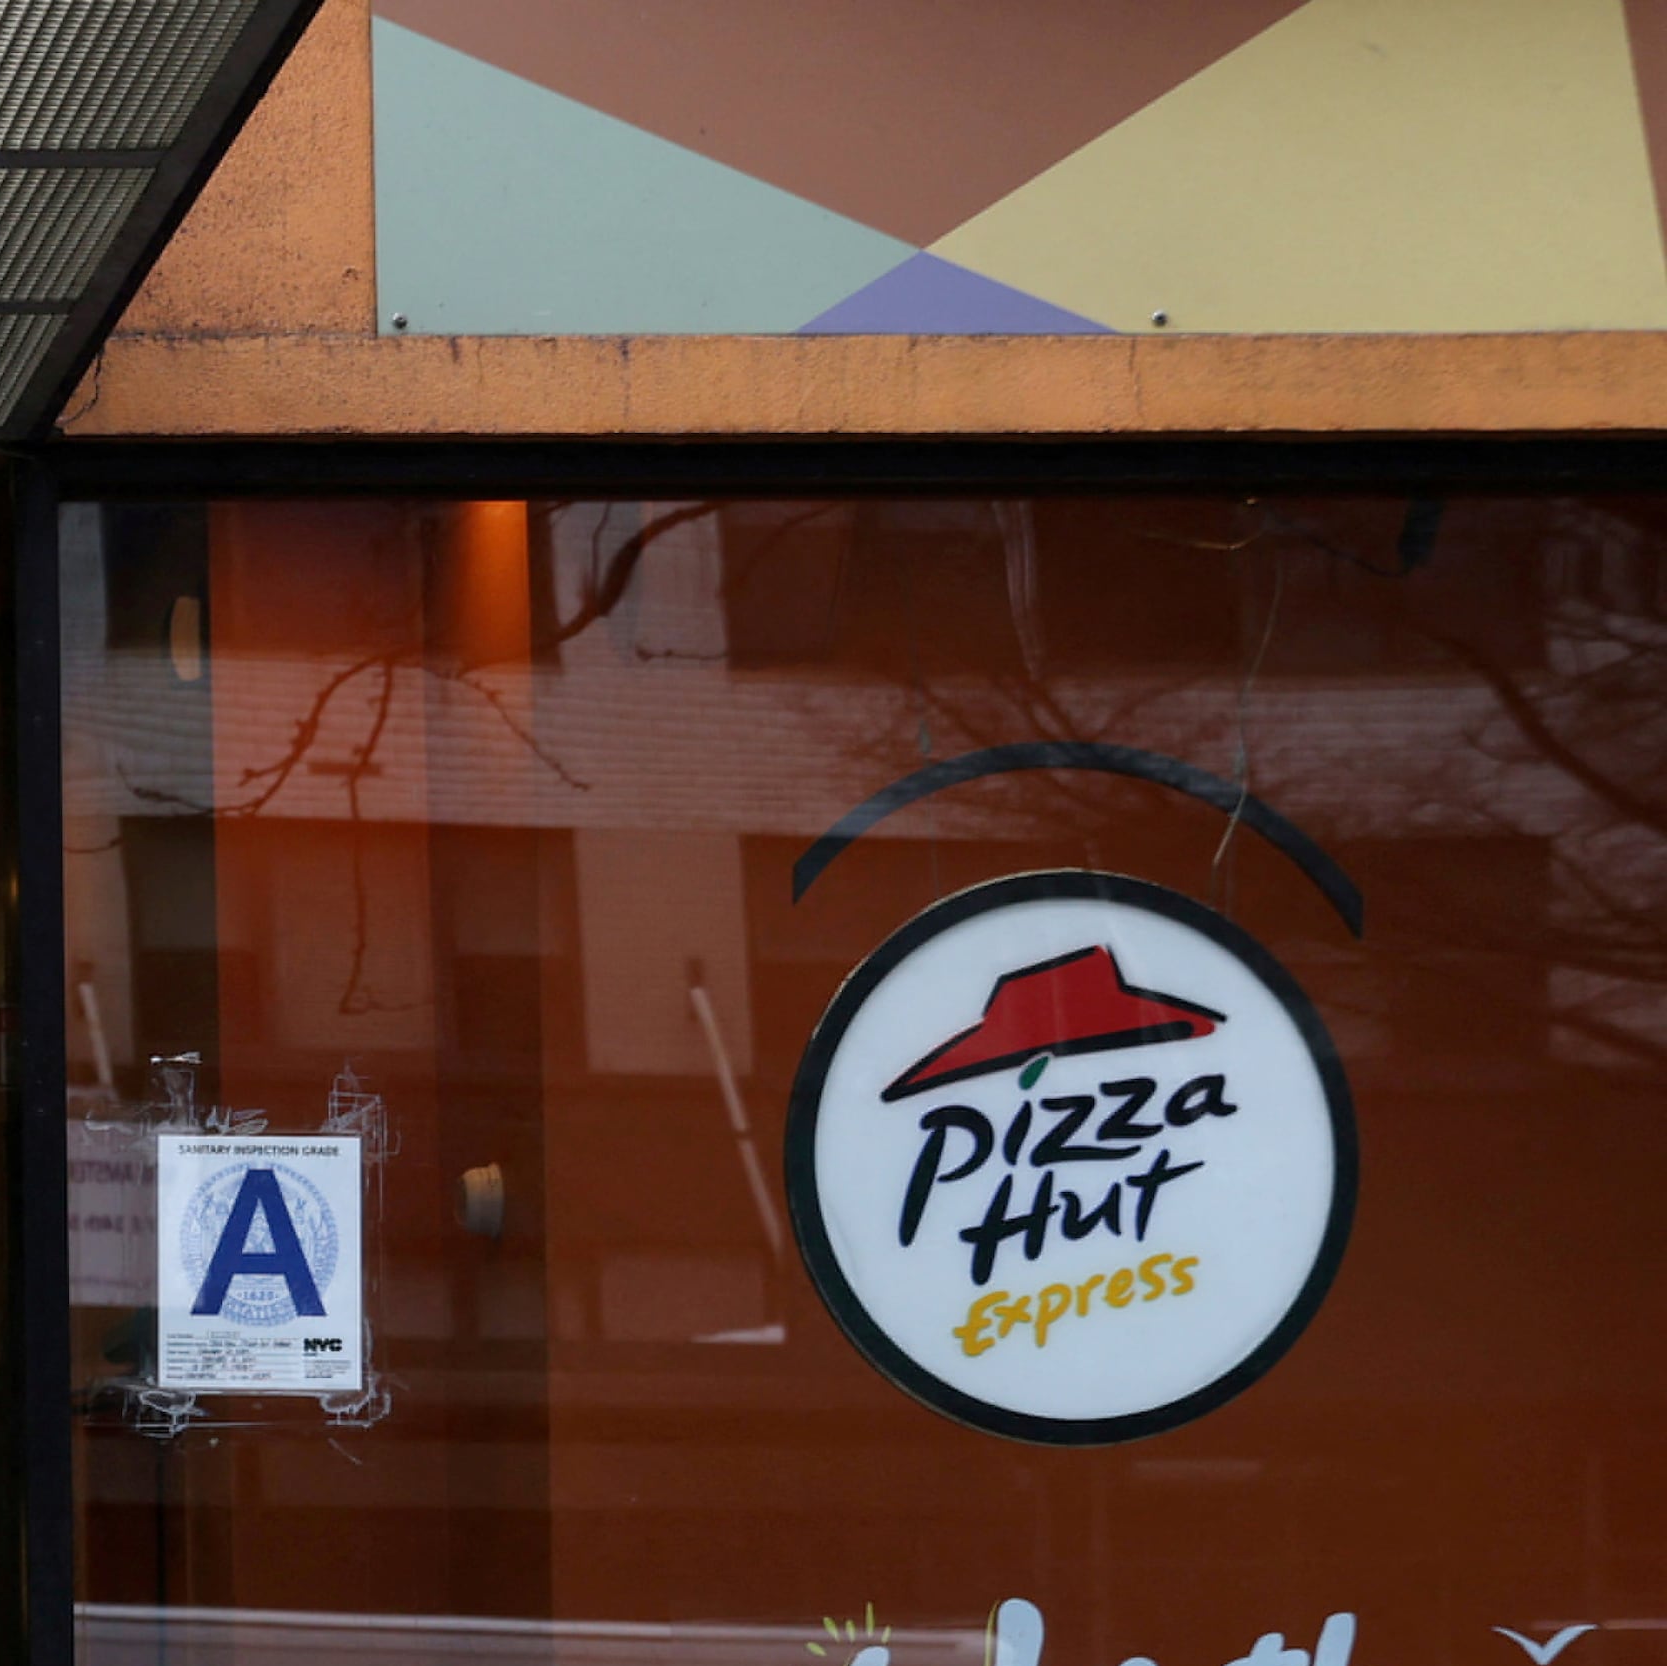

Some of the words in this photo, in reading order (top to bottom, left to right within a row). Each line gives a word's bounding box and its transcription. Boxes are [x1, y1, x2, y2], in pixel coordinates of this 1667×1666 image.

[178, 1144, 230, 1156] SANITARY
[233, 1144, 299, 1157] INSPECTION
[301, 1145, 340, 1157] GRADE
[898, 1056, 1238, 1248] Pizza
[190, 1168, 328, 1316] A
[959, 1149, 1205, 1286] Hut
[303, 1338, 343, 1352] NYC
[952, 1253, 1200, 1357] Express
